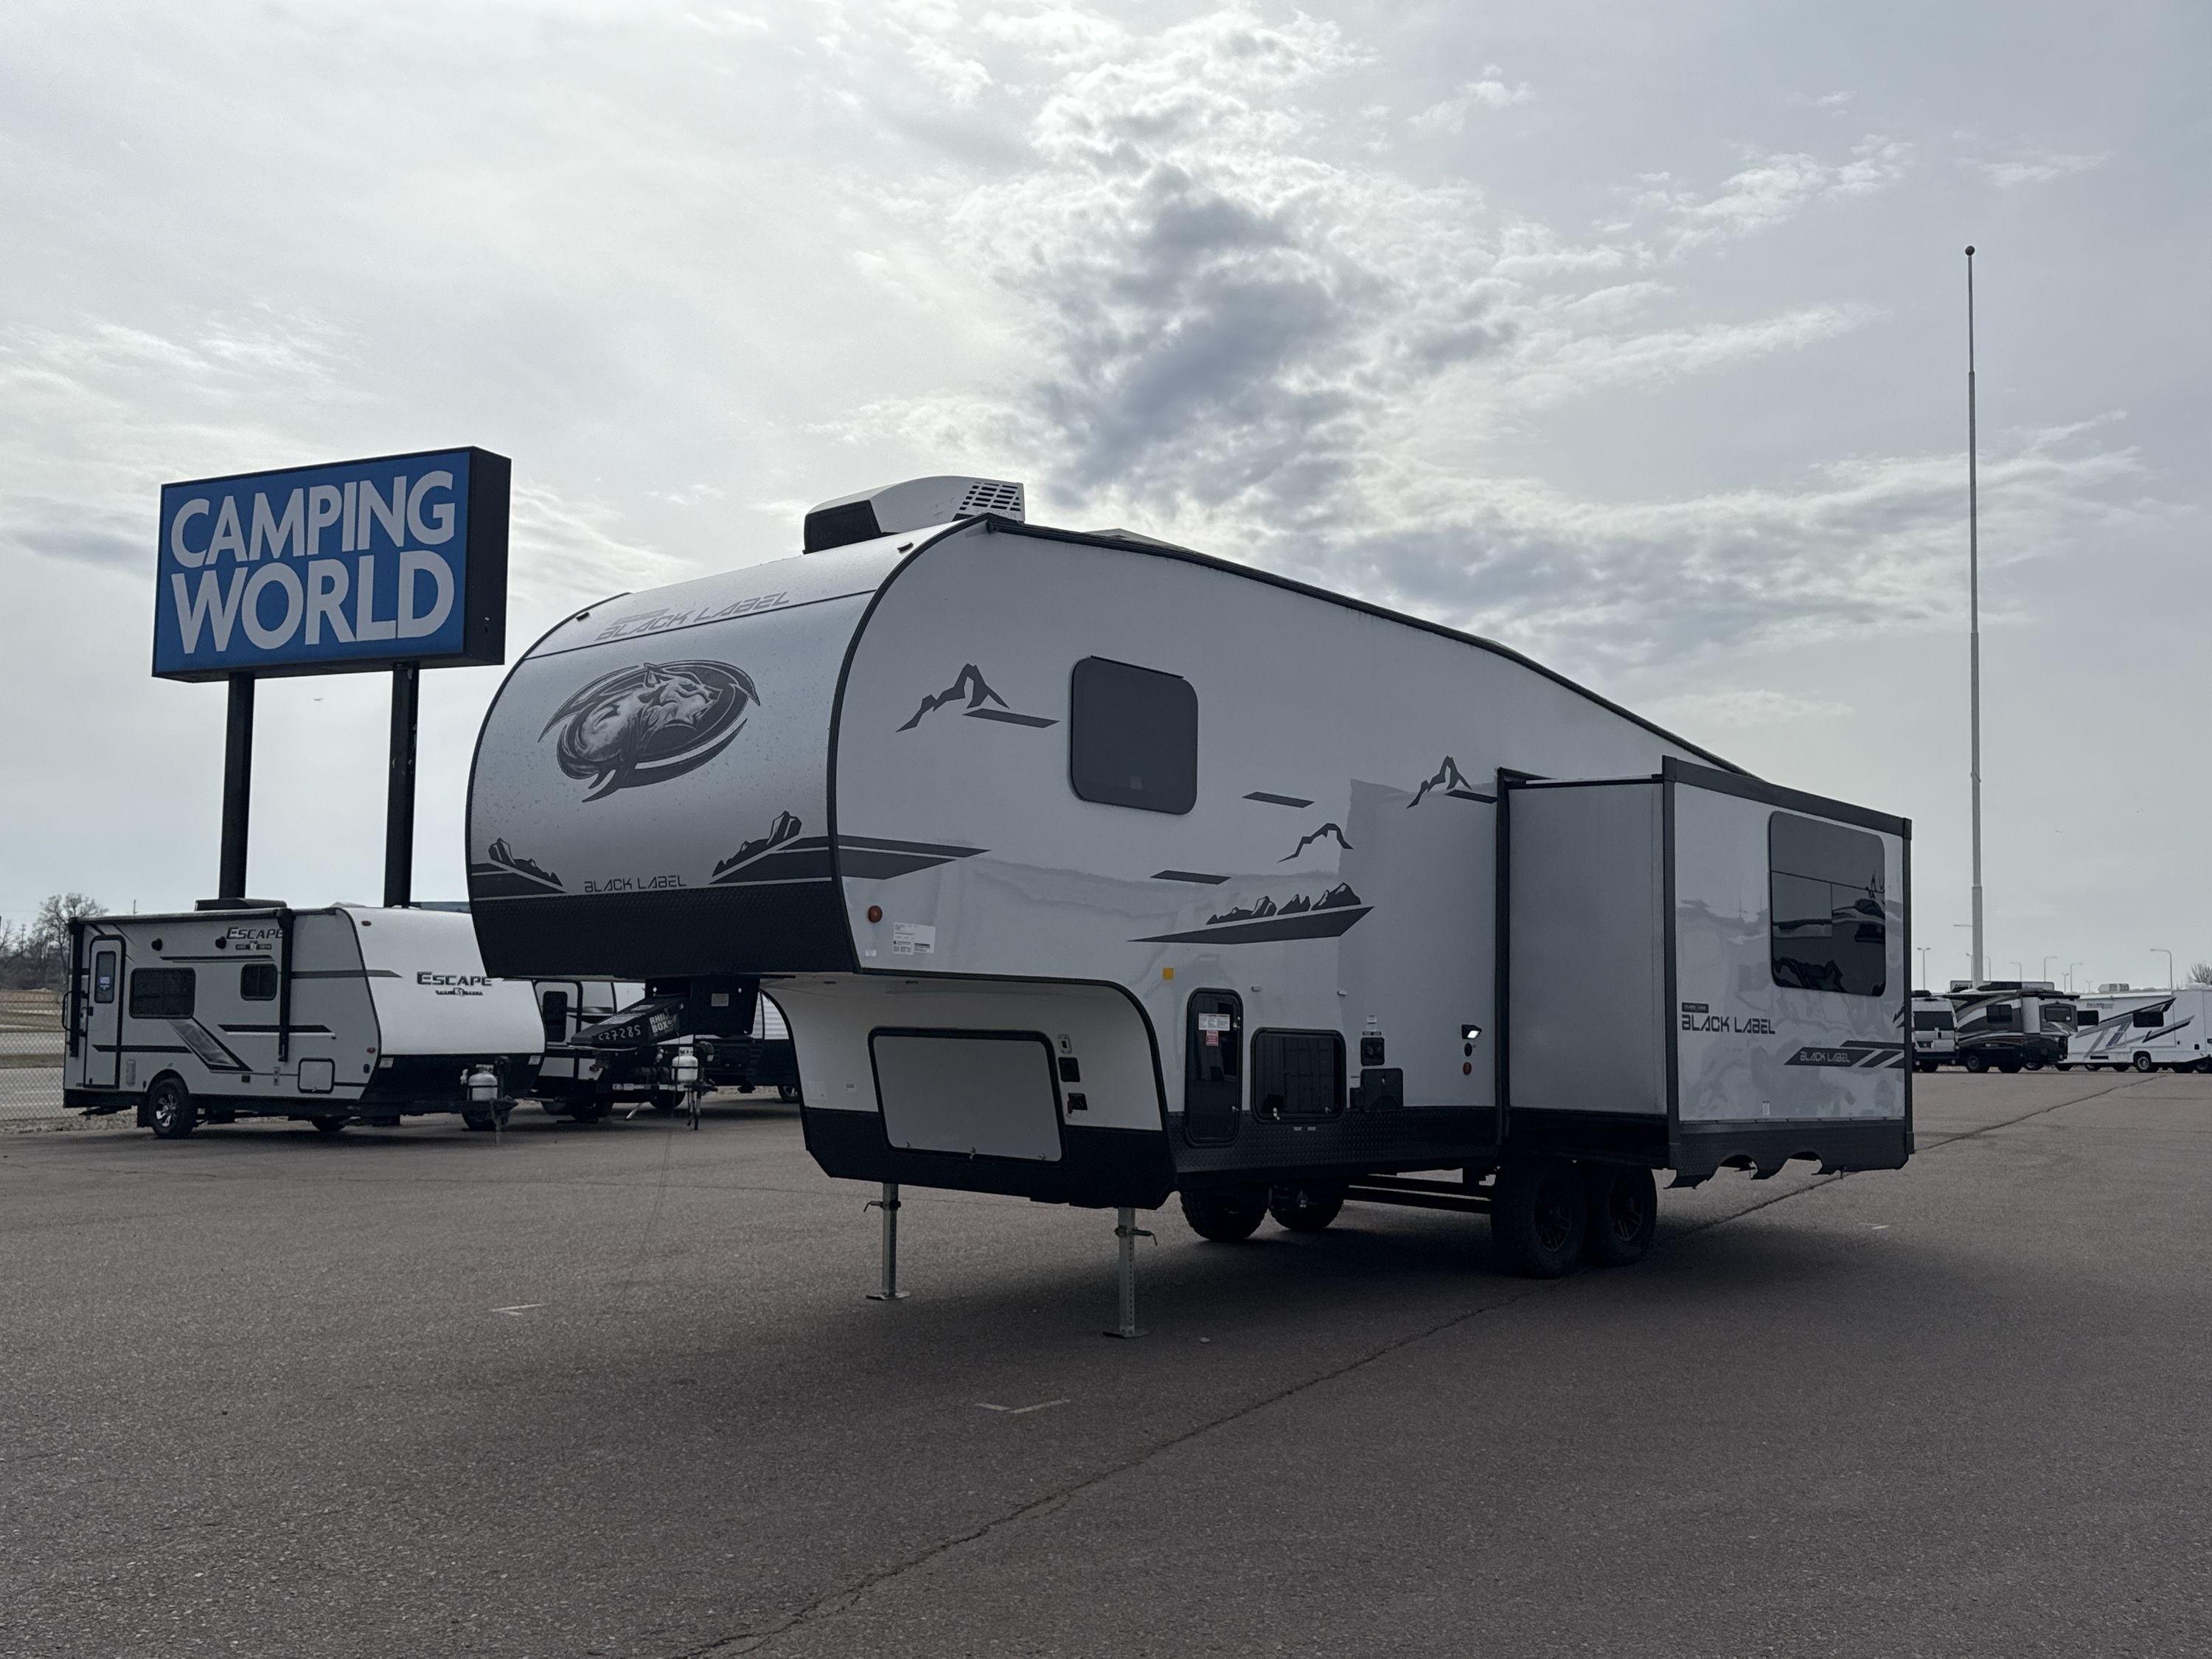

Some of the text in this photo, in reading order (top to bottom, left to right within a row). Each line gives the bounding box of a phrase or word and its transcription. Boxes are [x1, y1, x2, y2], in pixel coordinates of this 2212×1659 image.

[170, 470, 456, 568] CAMPING
[171, 550, 455, 654] WORLD
[595, 610, 695, 641] BLACK
[693, 591, 790, 622] LABEL
[584, 874, 687, 893] BLACK LABEL
[417, 972, 492, 986] ESCAPE
[652, 1020, 669, 1033] BOX
[1682, 1014, 1775, 1034] BLACK LABEL
[1800, 1051, 1851, 1062] BLACK LABEL
